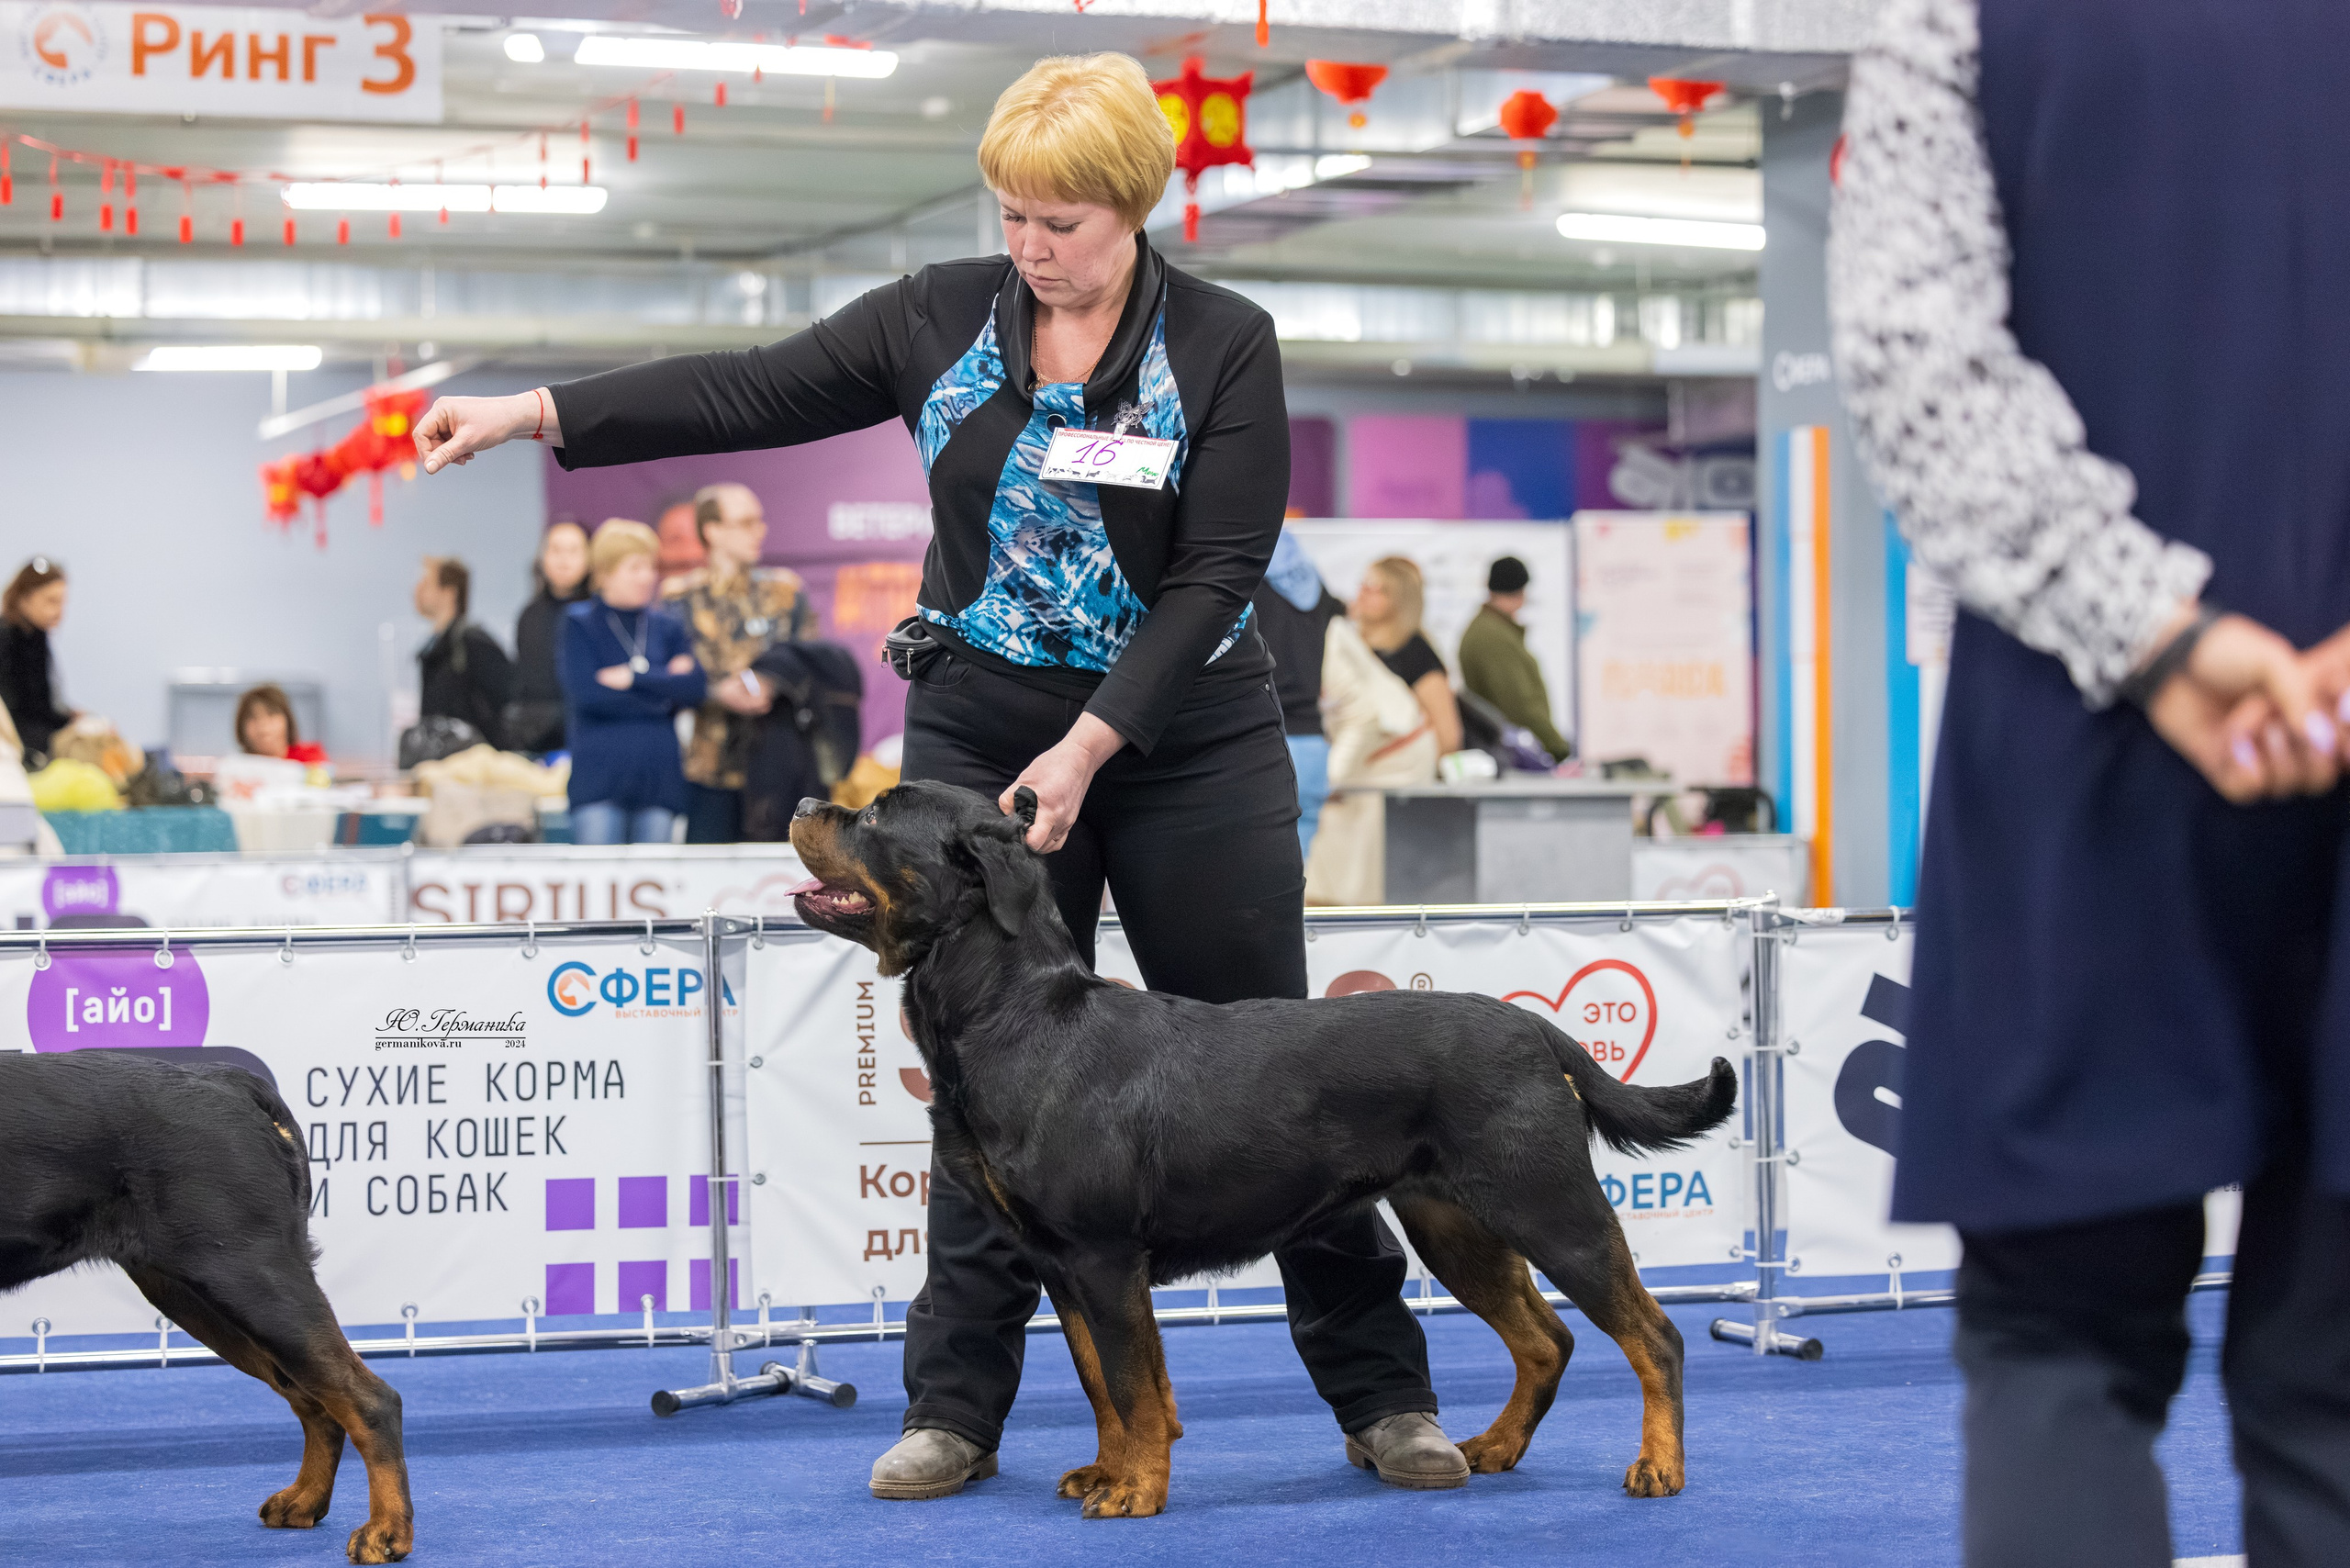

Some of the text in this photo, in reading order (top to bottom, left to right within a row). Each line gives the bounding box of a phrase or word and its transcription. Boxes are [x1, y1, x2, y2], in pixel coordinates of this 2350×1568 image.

[131, 13, 337, 83] Ринг
[361, 14, 417, 95] 3
[1071, 440, 1125, 465] 16
[615, 1007, 701, 1019] ВЫСТАВОЧНЫЙ
[1583, 1002, 1637, 1024] ЭТО
[856, 981, 876, 1106] PREMIUM
[307, 1060, 625, 1107] СУХИЕ КОРМА
[308, 1115, 568, 1170] ДЛЯ КОШЕК
[366, 1171, 509, 1216] СОБАК
[863, 1228, 927, 1261] дл
